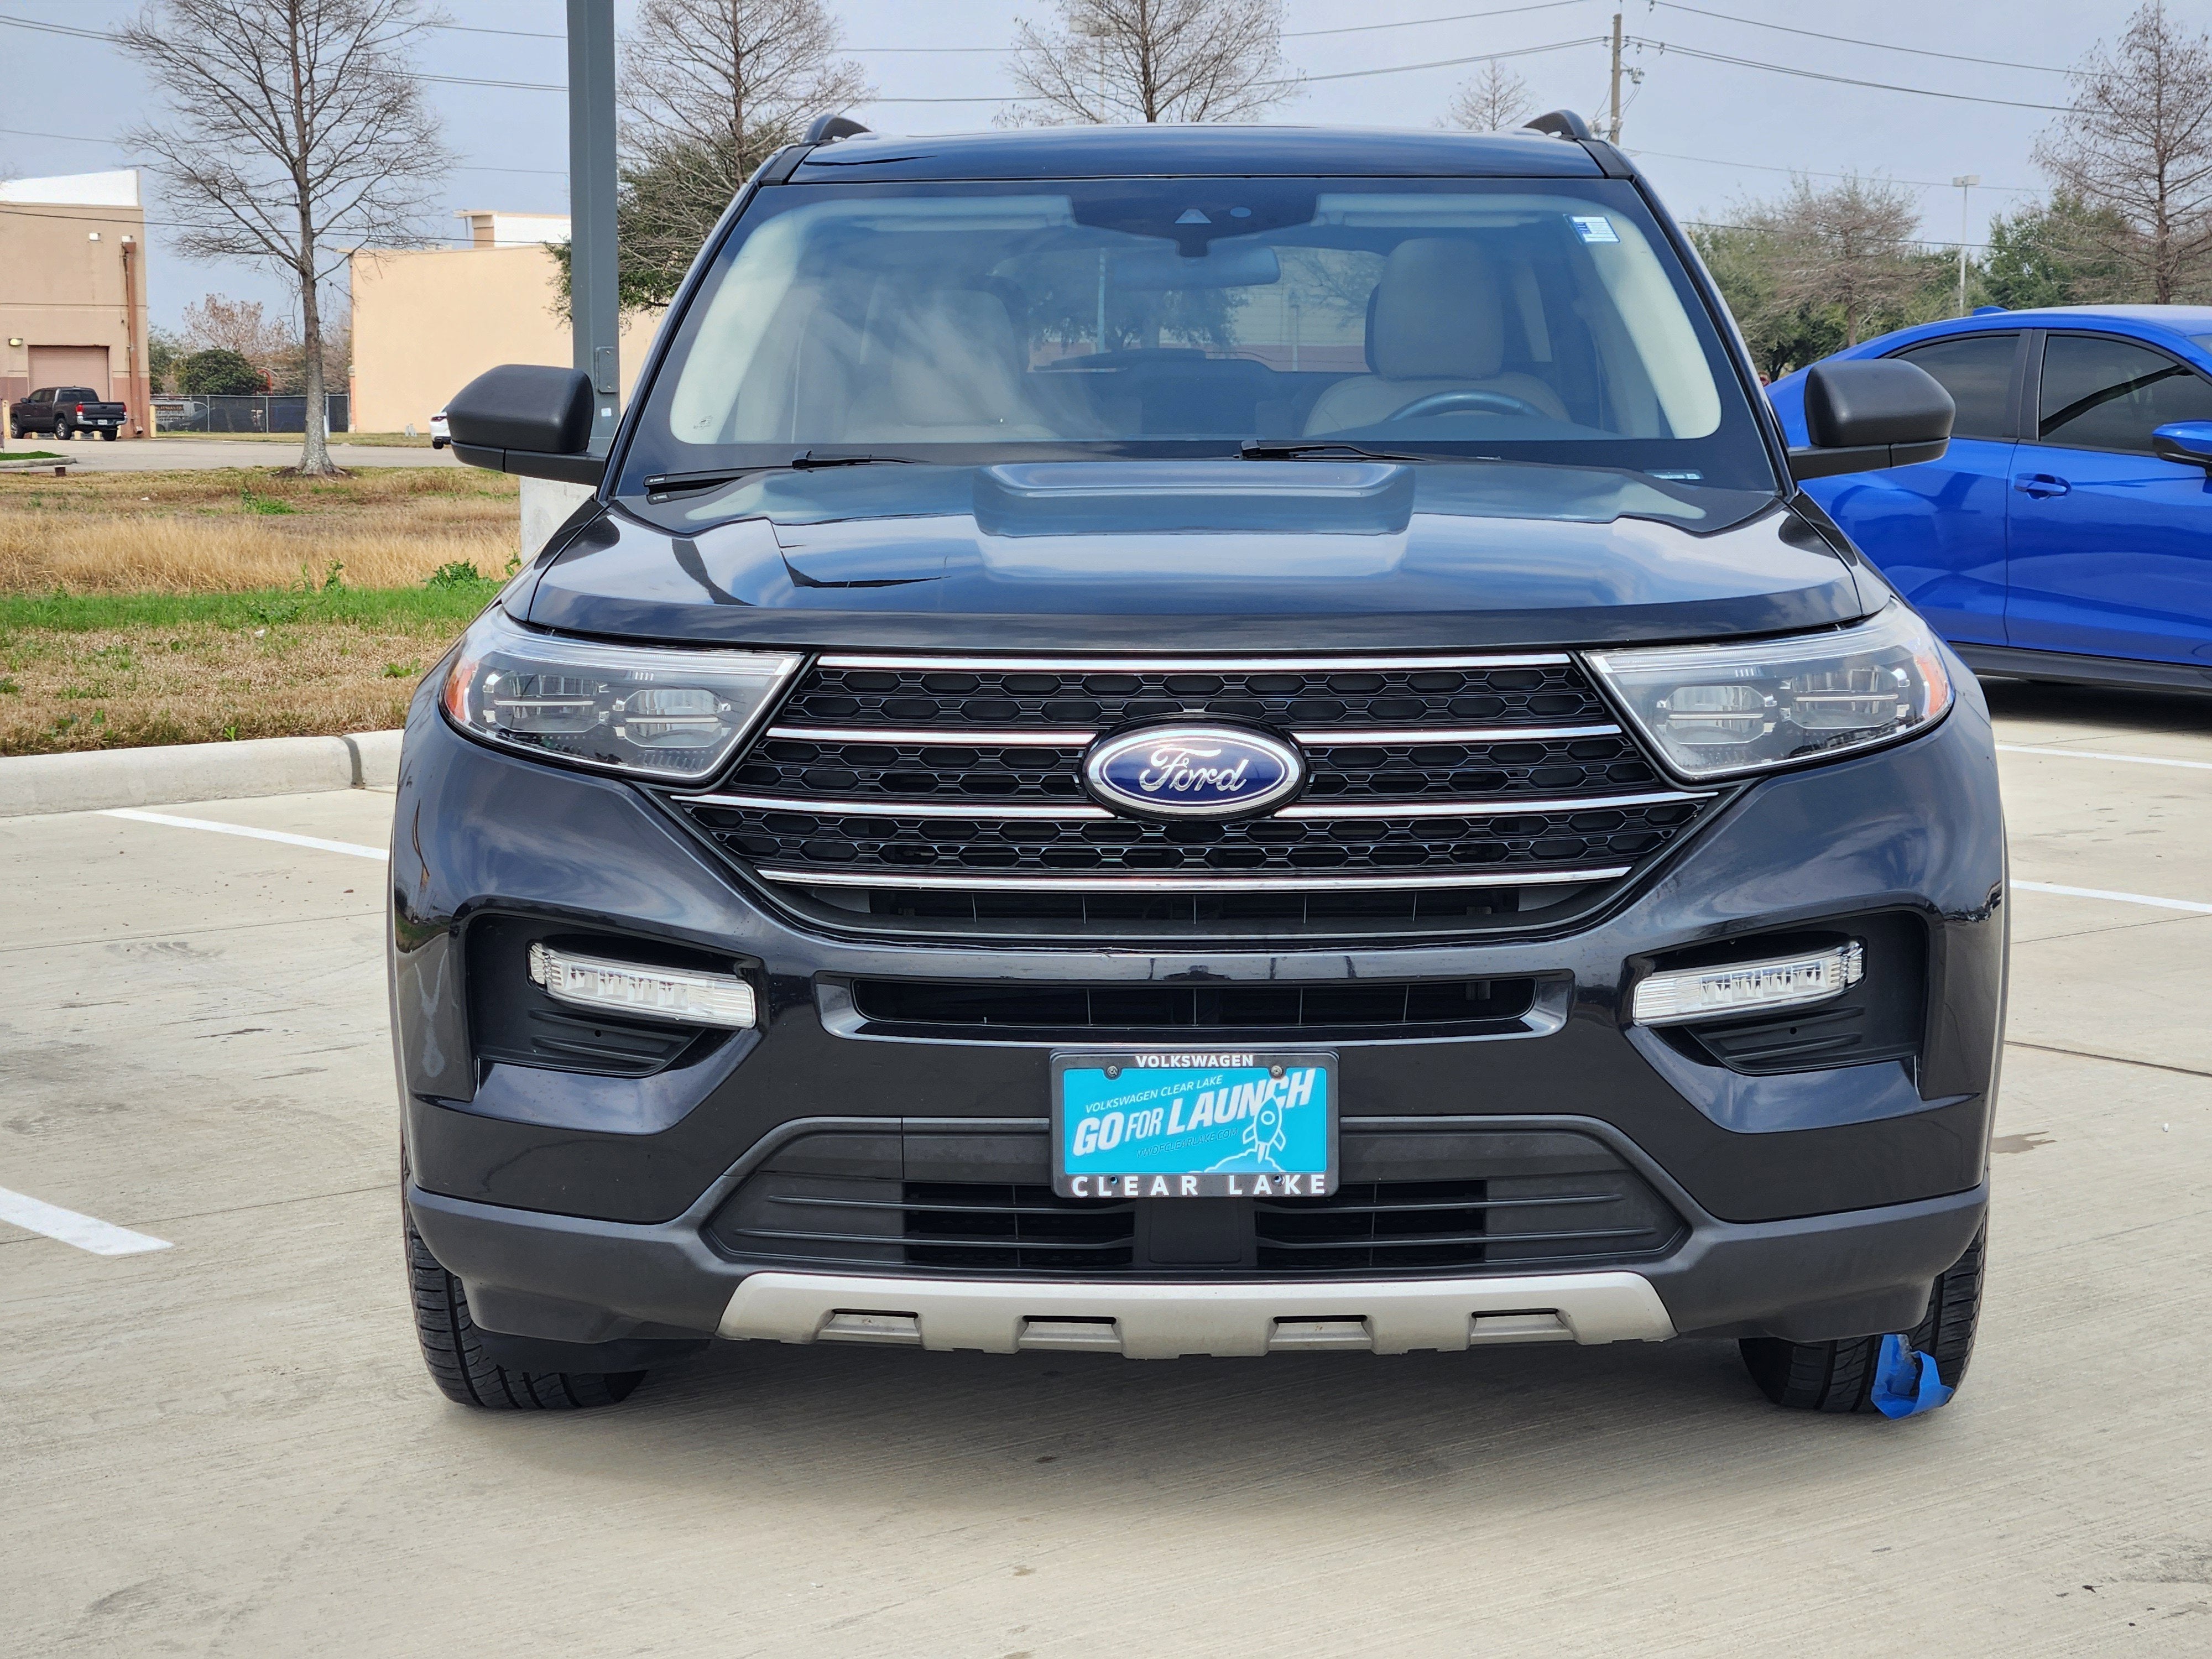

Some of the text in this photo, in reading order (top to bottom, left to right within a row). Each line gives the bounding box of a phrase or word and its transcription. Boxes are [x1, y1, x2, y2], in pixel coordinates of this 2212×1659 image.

[1139, 746, 1249, 791] Ford
[1136, 1055, 1254, 1068] VOLKSWAGEN
[1073, 1068, 1316, 1156] GO FOR LAUNCH
[1086, 1074, 1223, 1113] VOLKSWAGEN CLEAR LAKE
[1072, 1174, 1326, 1197] CLEAR LAKE
